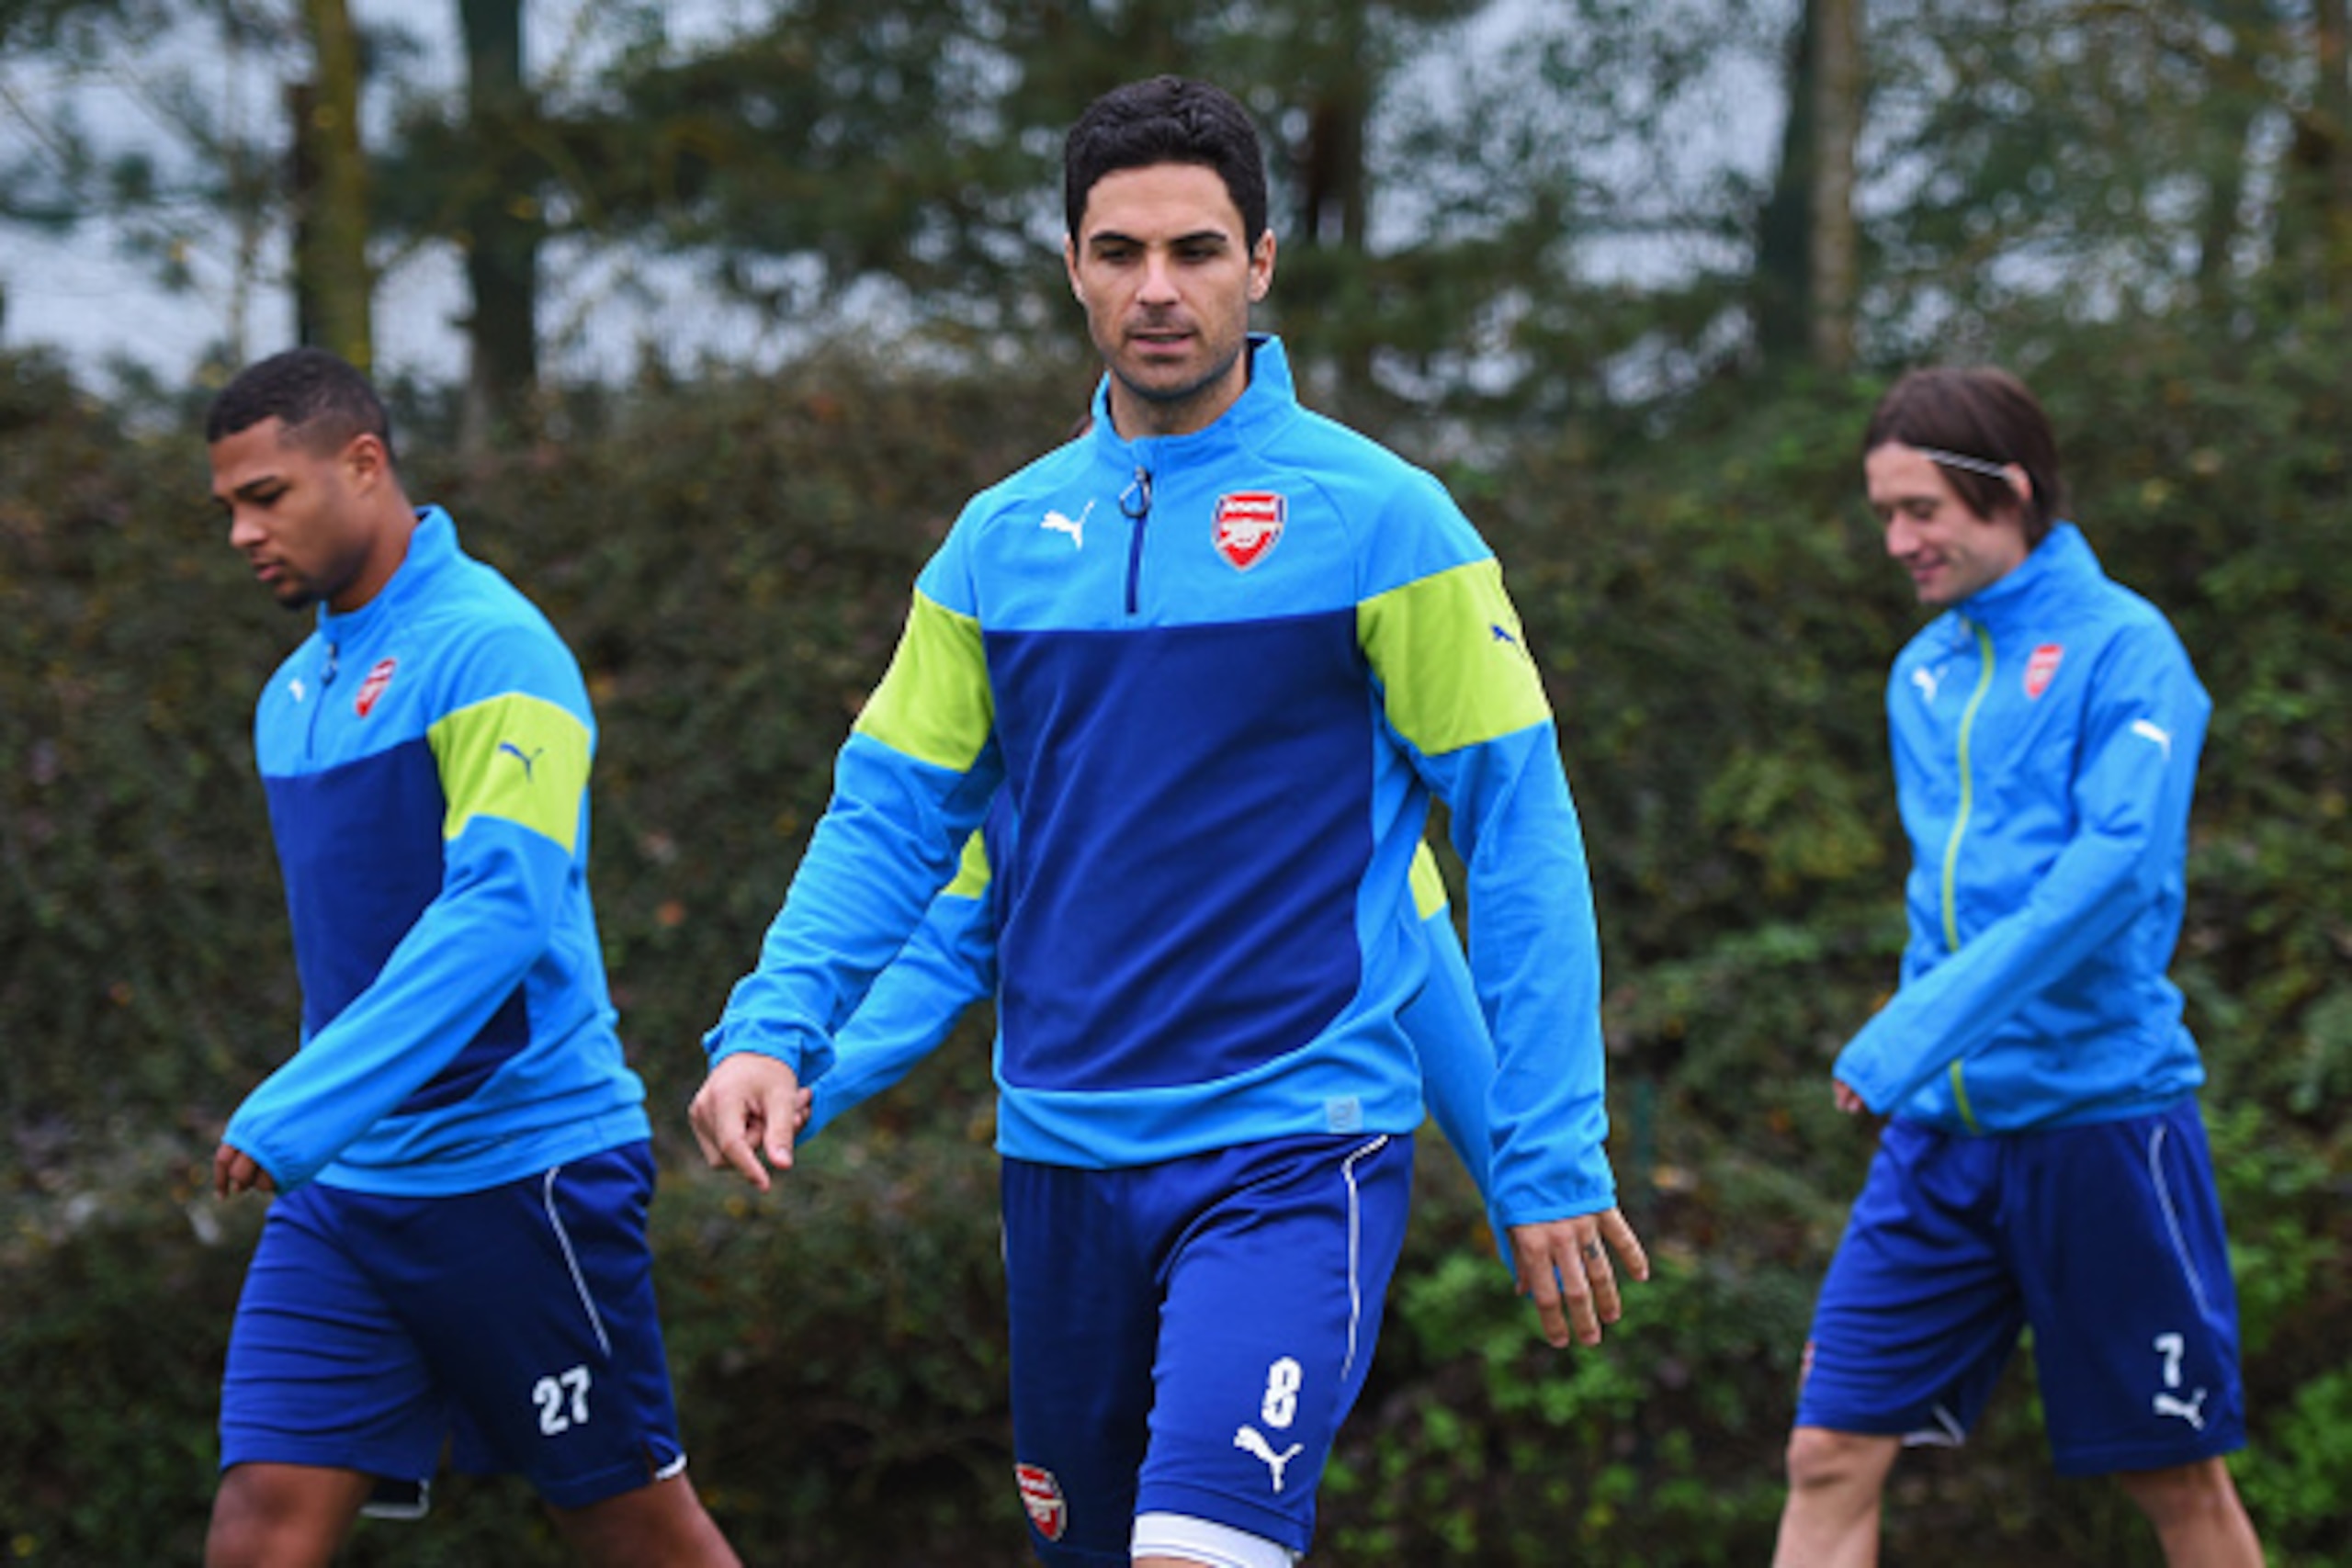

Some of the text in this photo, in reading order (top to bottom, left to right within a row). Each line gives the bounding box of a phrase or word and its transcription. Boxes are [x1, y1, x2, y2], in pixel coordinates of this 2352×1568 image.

[1261, 1356, 1302, 1427] 8
[2154, 1333, 2184, 1388] 7
[532, 1364, 591, 1436] 27
